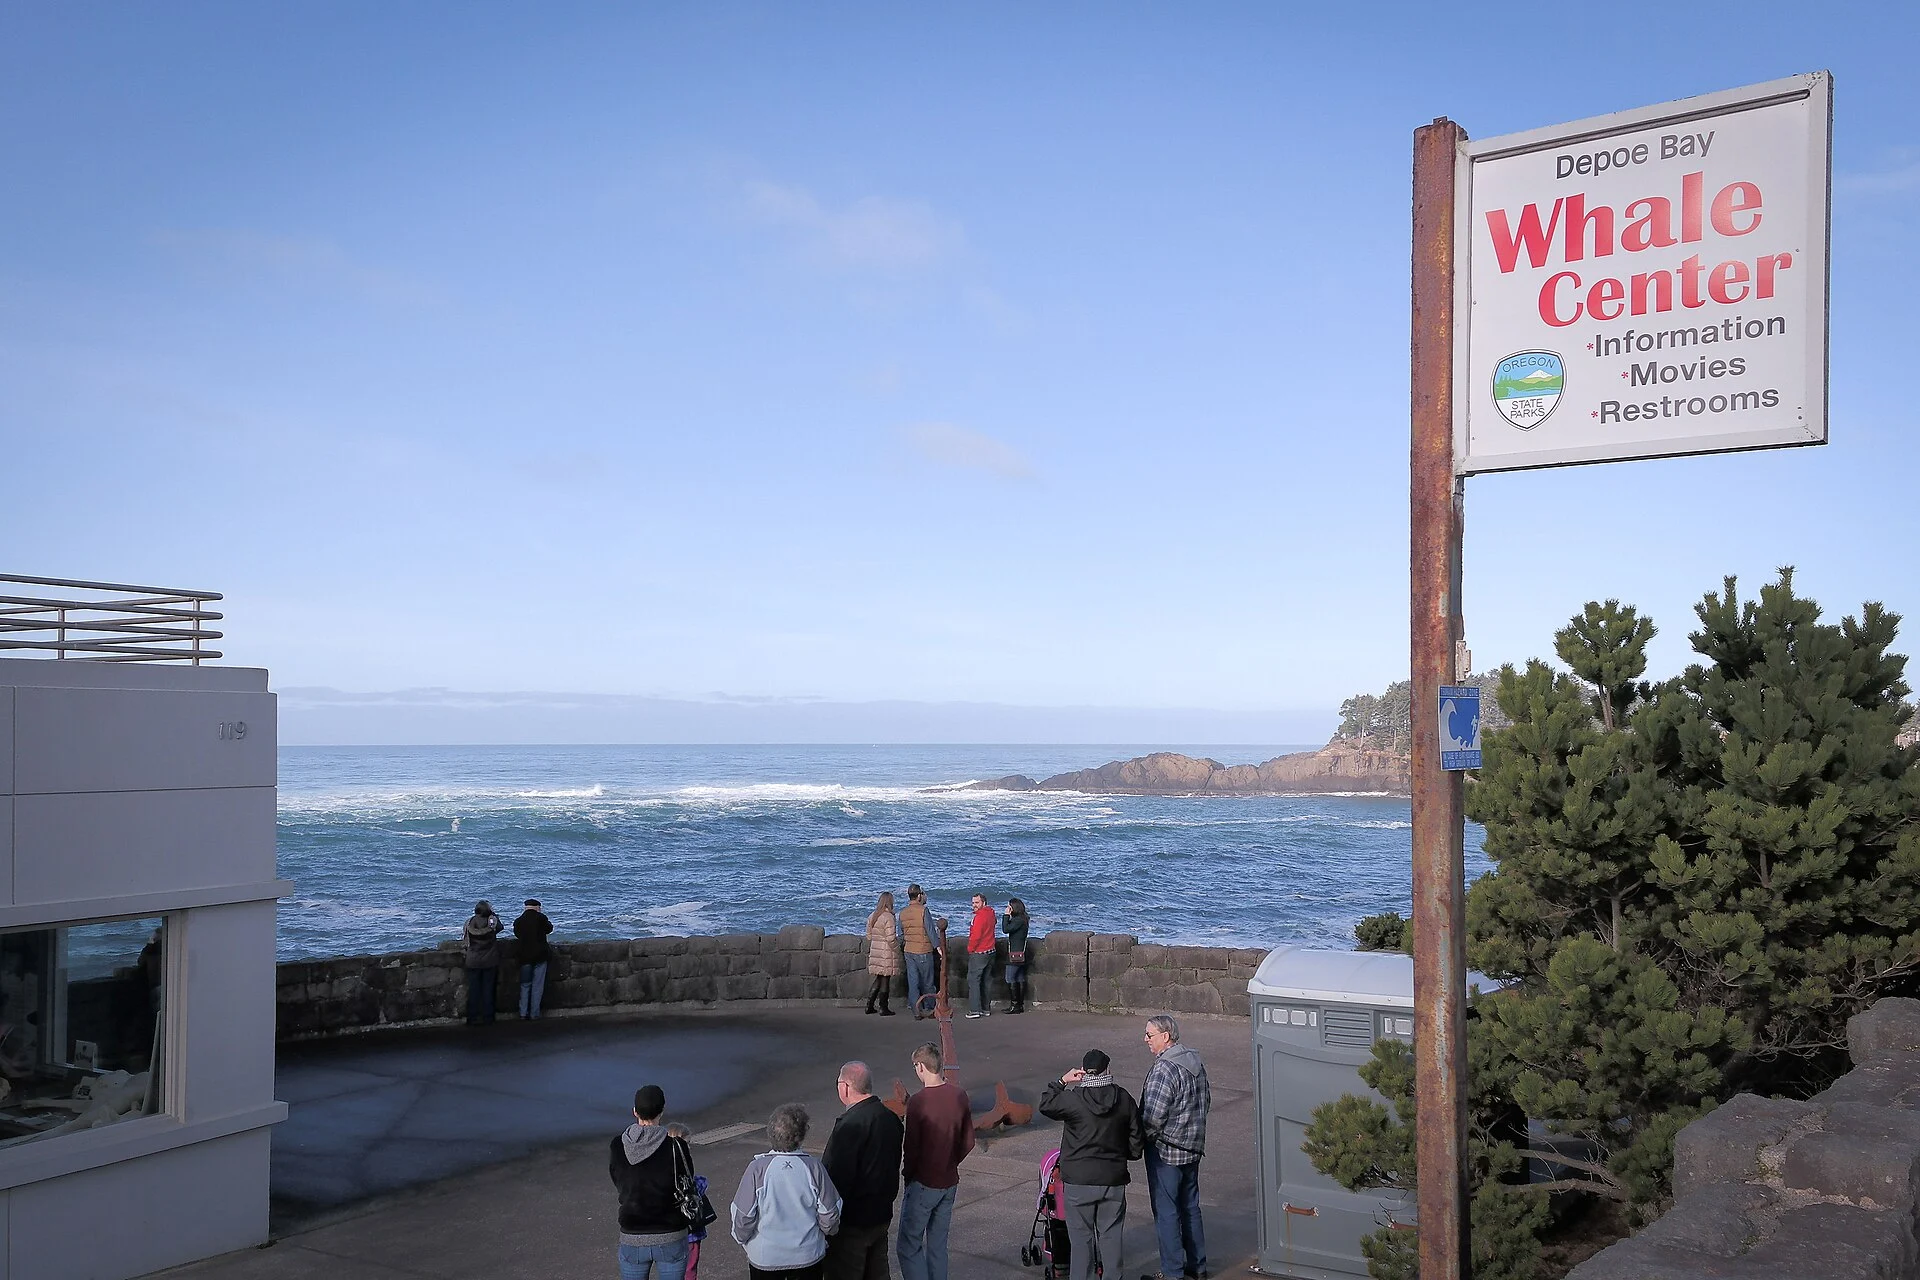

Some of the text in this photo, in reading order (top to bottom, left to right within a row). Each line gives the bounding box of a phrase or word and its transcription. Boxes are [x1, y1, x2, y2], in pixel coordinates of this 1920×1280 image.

[1556, 131, 1716, 179] Depoe Bay
[1486, 171, 1764, 274] Whale
[1538, 250, 1793, 327] Center
[1595, 315, 1786, 357] Information
[1502, 356, 1555, 373] OREGON
[1630, 355, 1746, 387] Movies
[1510, 408, 1546, 419] PARKS
[1511, 398, 1543, 410] STATE
[1600, 388, 1779, 424] Restrooms
[218, 721, 248, 740] 119
